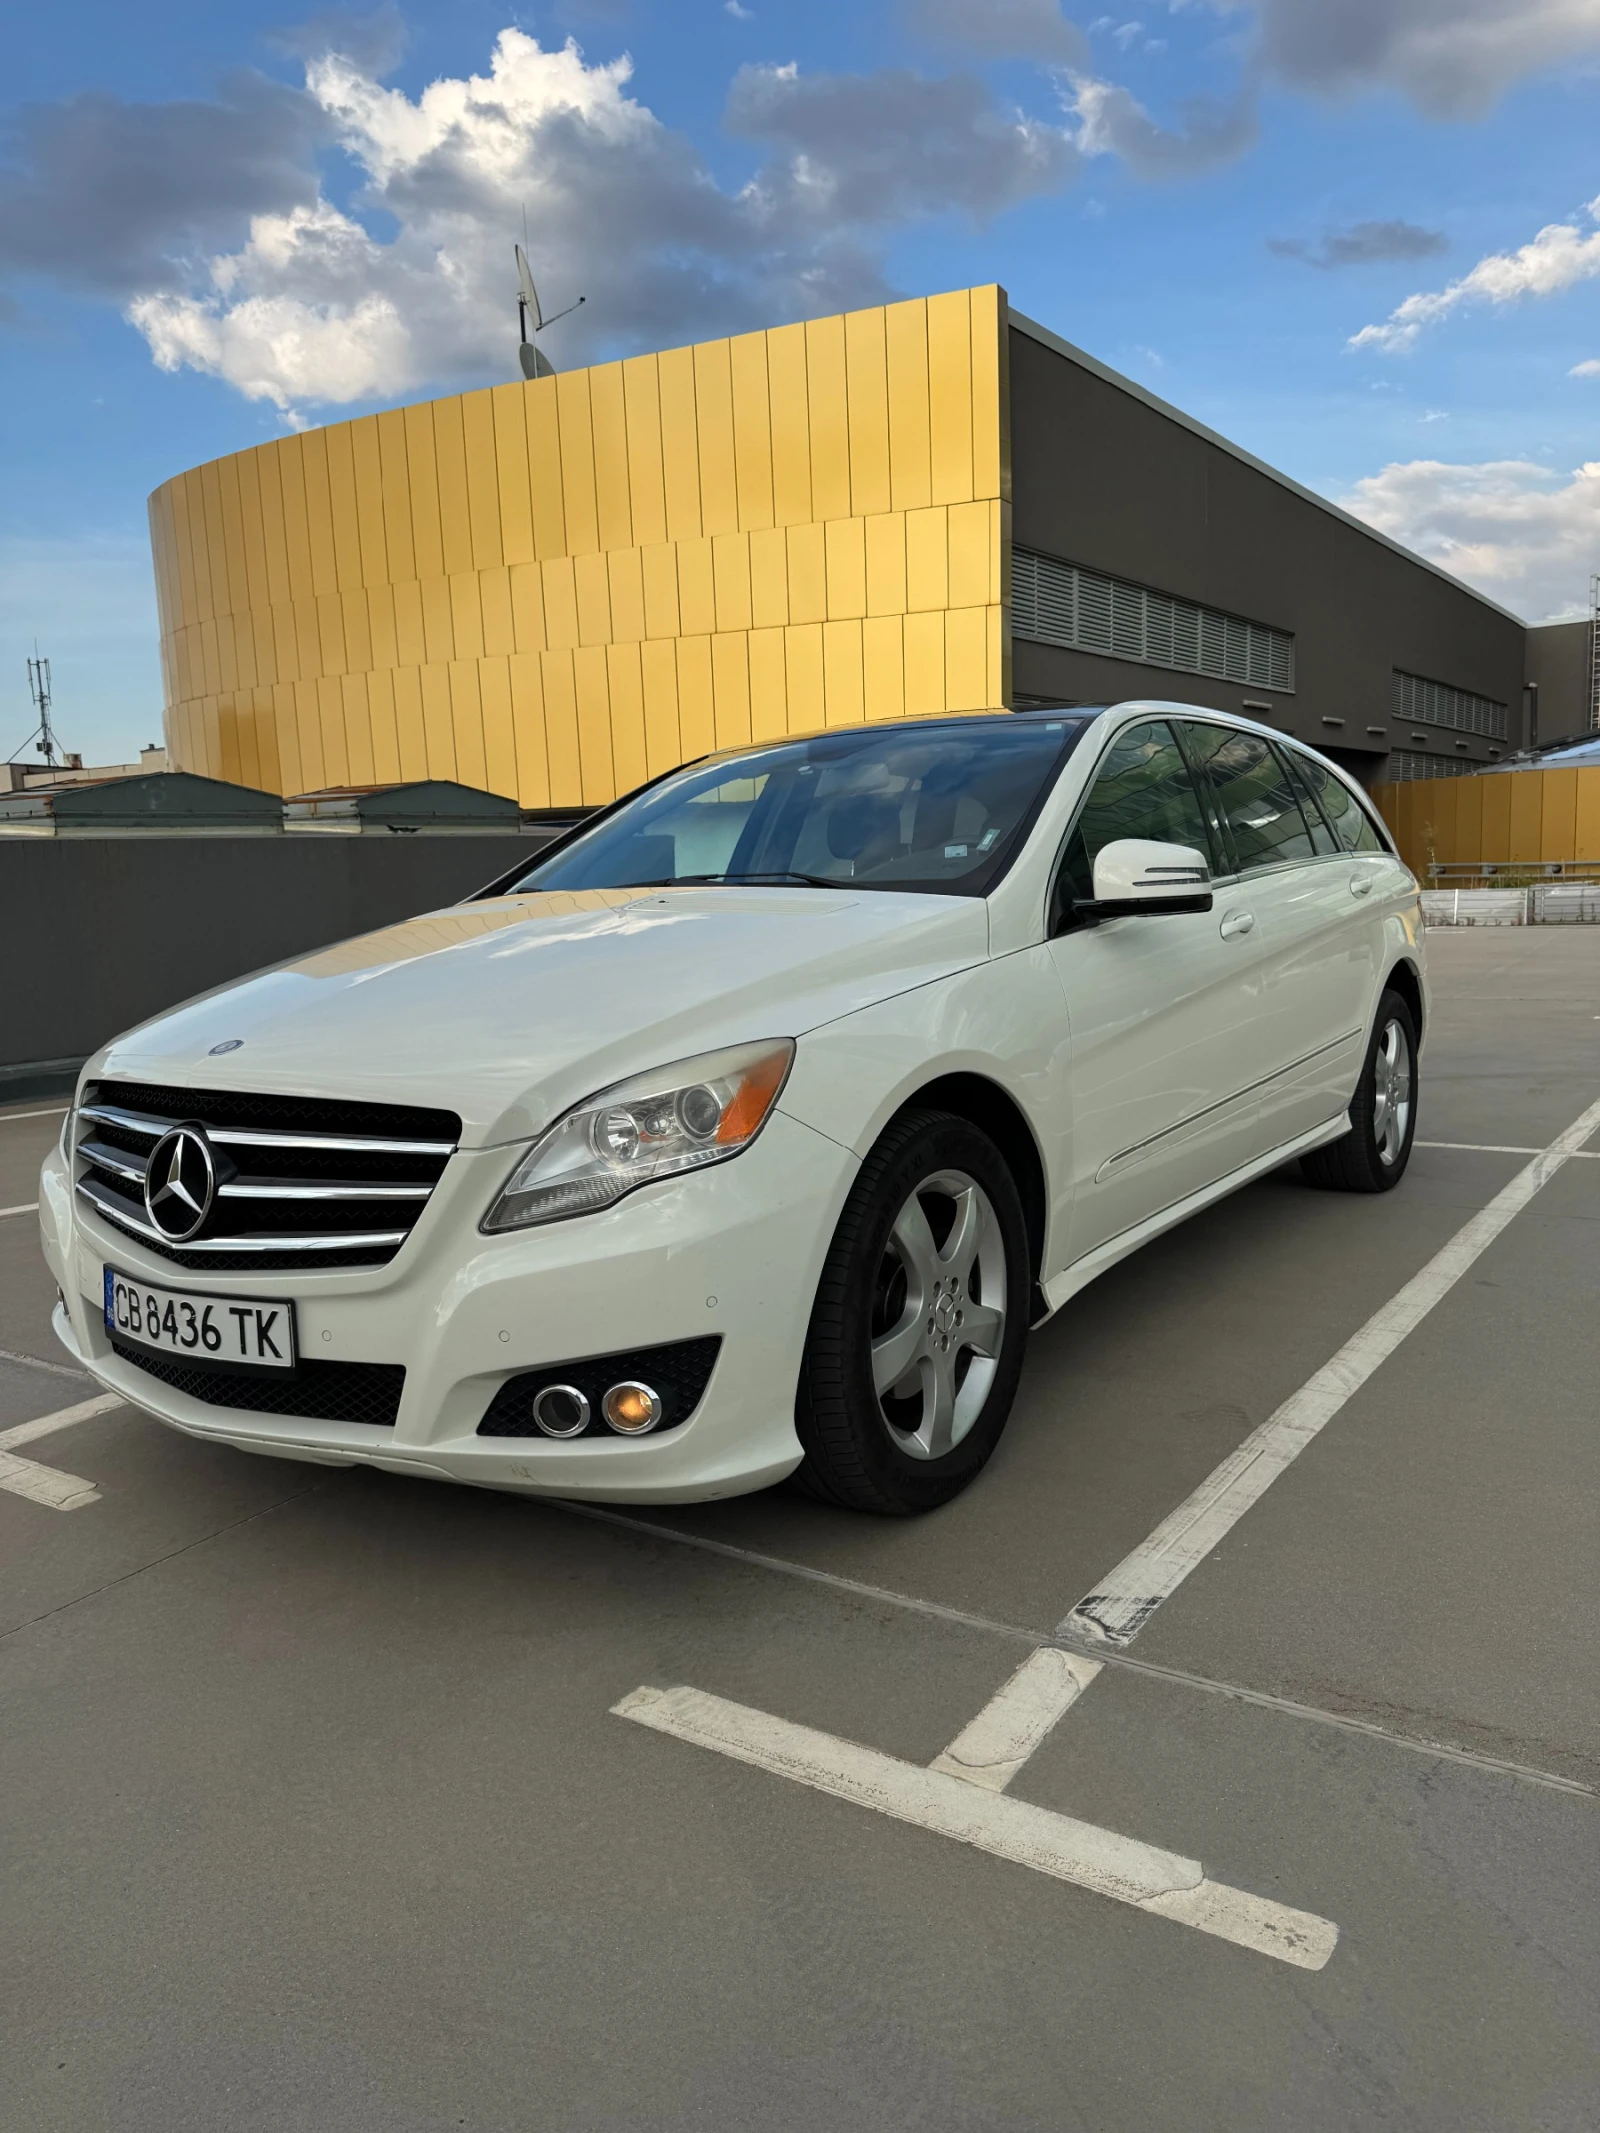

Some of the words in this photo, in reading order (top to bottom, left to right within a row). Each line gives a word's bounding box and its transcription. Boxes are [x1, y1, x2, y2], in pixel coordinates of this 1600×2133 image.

[116, 1283, 142, 1333] CB
[147, 1294, 222, 1351] 8436
[229, 1307, 283, 1358] TK
